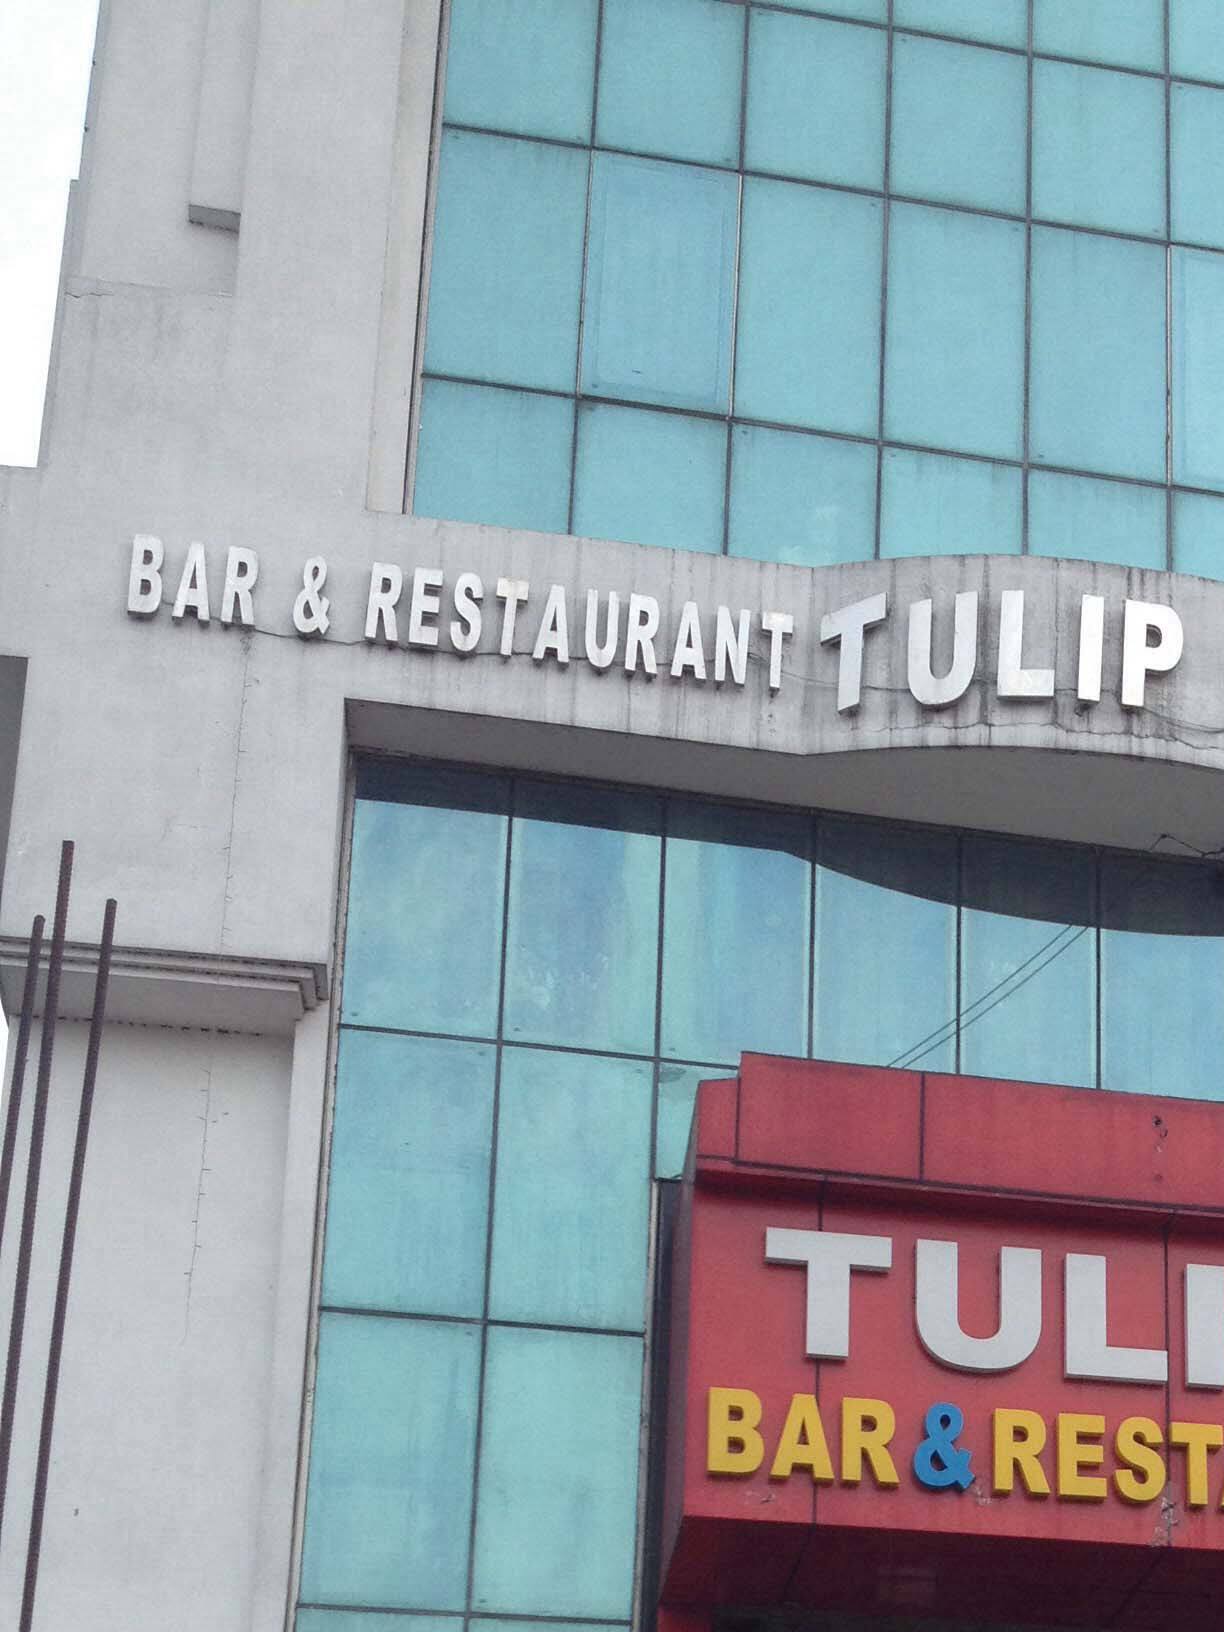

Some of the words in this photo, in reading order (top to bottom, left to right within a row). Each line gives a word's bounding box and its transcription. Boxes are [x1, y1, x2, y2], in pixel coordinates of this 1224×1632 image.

[127, 534, 259, 629] BAR
[292, 556, 331, 636] &
[364, 562, 794, 693] RESTAURANT
[820, 590, 1184, 714] TULIP
[707, 1387, 900, 1487] BAR
[913, 1402, 976, 1492] &
